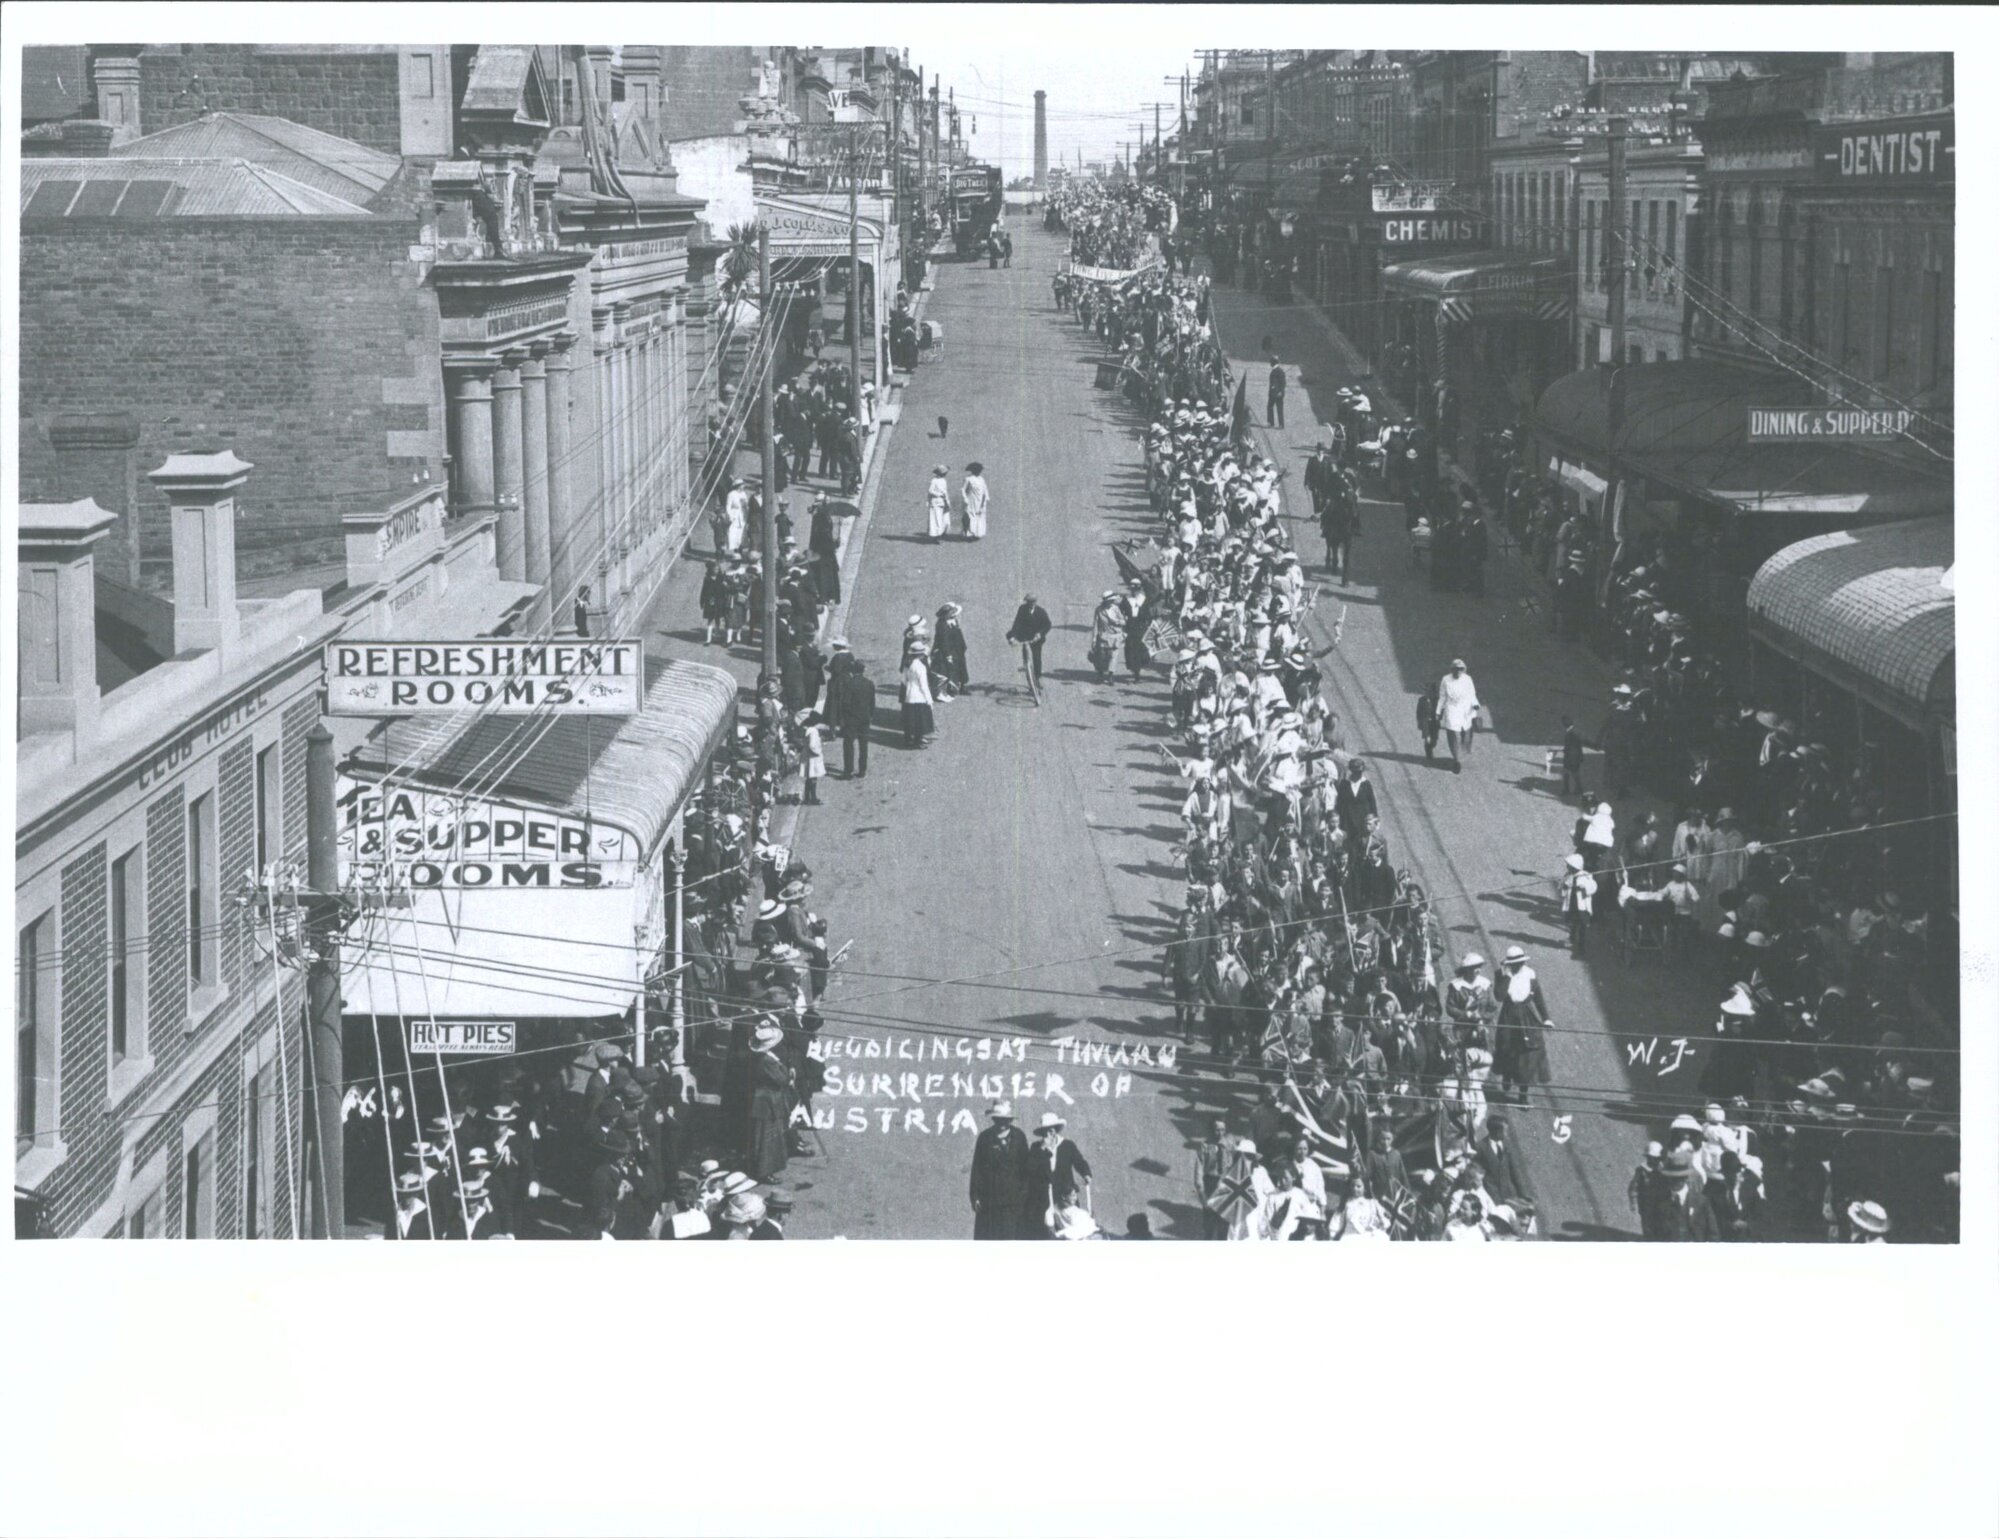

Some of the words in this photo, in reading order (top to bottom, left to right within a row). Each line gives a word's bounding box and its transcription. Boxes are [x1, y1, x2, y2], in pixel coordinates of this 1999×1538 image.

[1841, 130, 1941, 175] DENTIST
[1385, 219, 1485, 241] CHEMIST
[1751, 411, 1808, 435] DINING
[1812, 417, 1823, 435] &
[1826, 411, 1893, 435] SUPPER
[338, 647, 630, 677] REFRESHMENT
[391, 680, 586, 706] ROOMS.
[137, 735, 193, 791] CLUB
[206, 687, 267, 744] HOTEL
[336, 784, 417, 826] TEA
[359, 828, 383, 855] &
[395, 819, 592, 856] SUPPER
[349, 862, 615, 888] OOMS.
[413, 1024, 454, 1043] HOT
[463, 1024, 512, 1043] PIES
